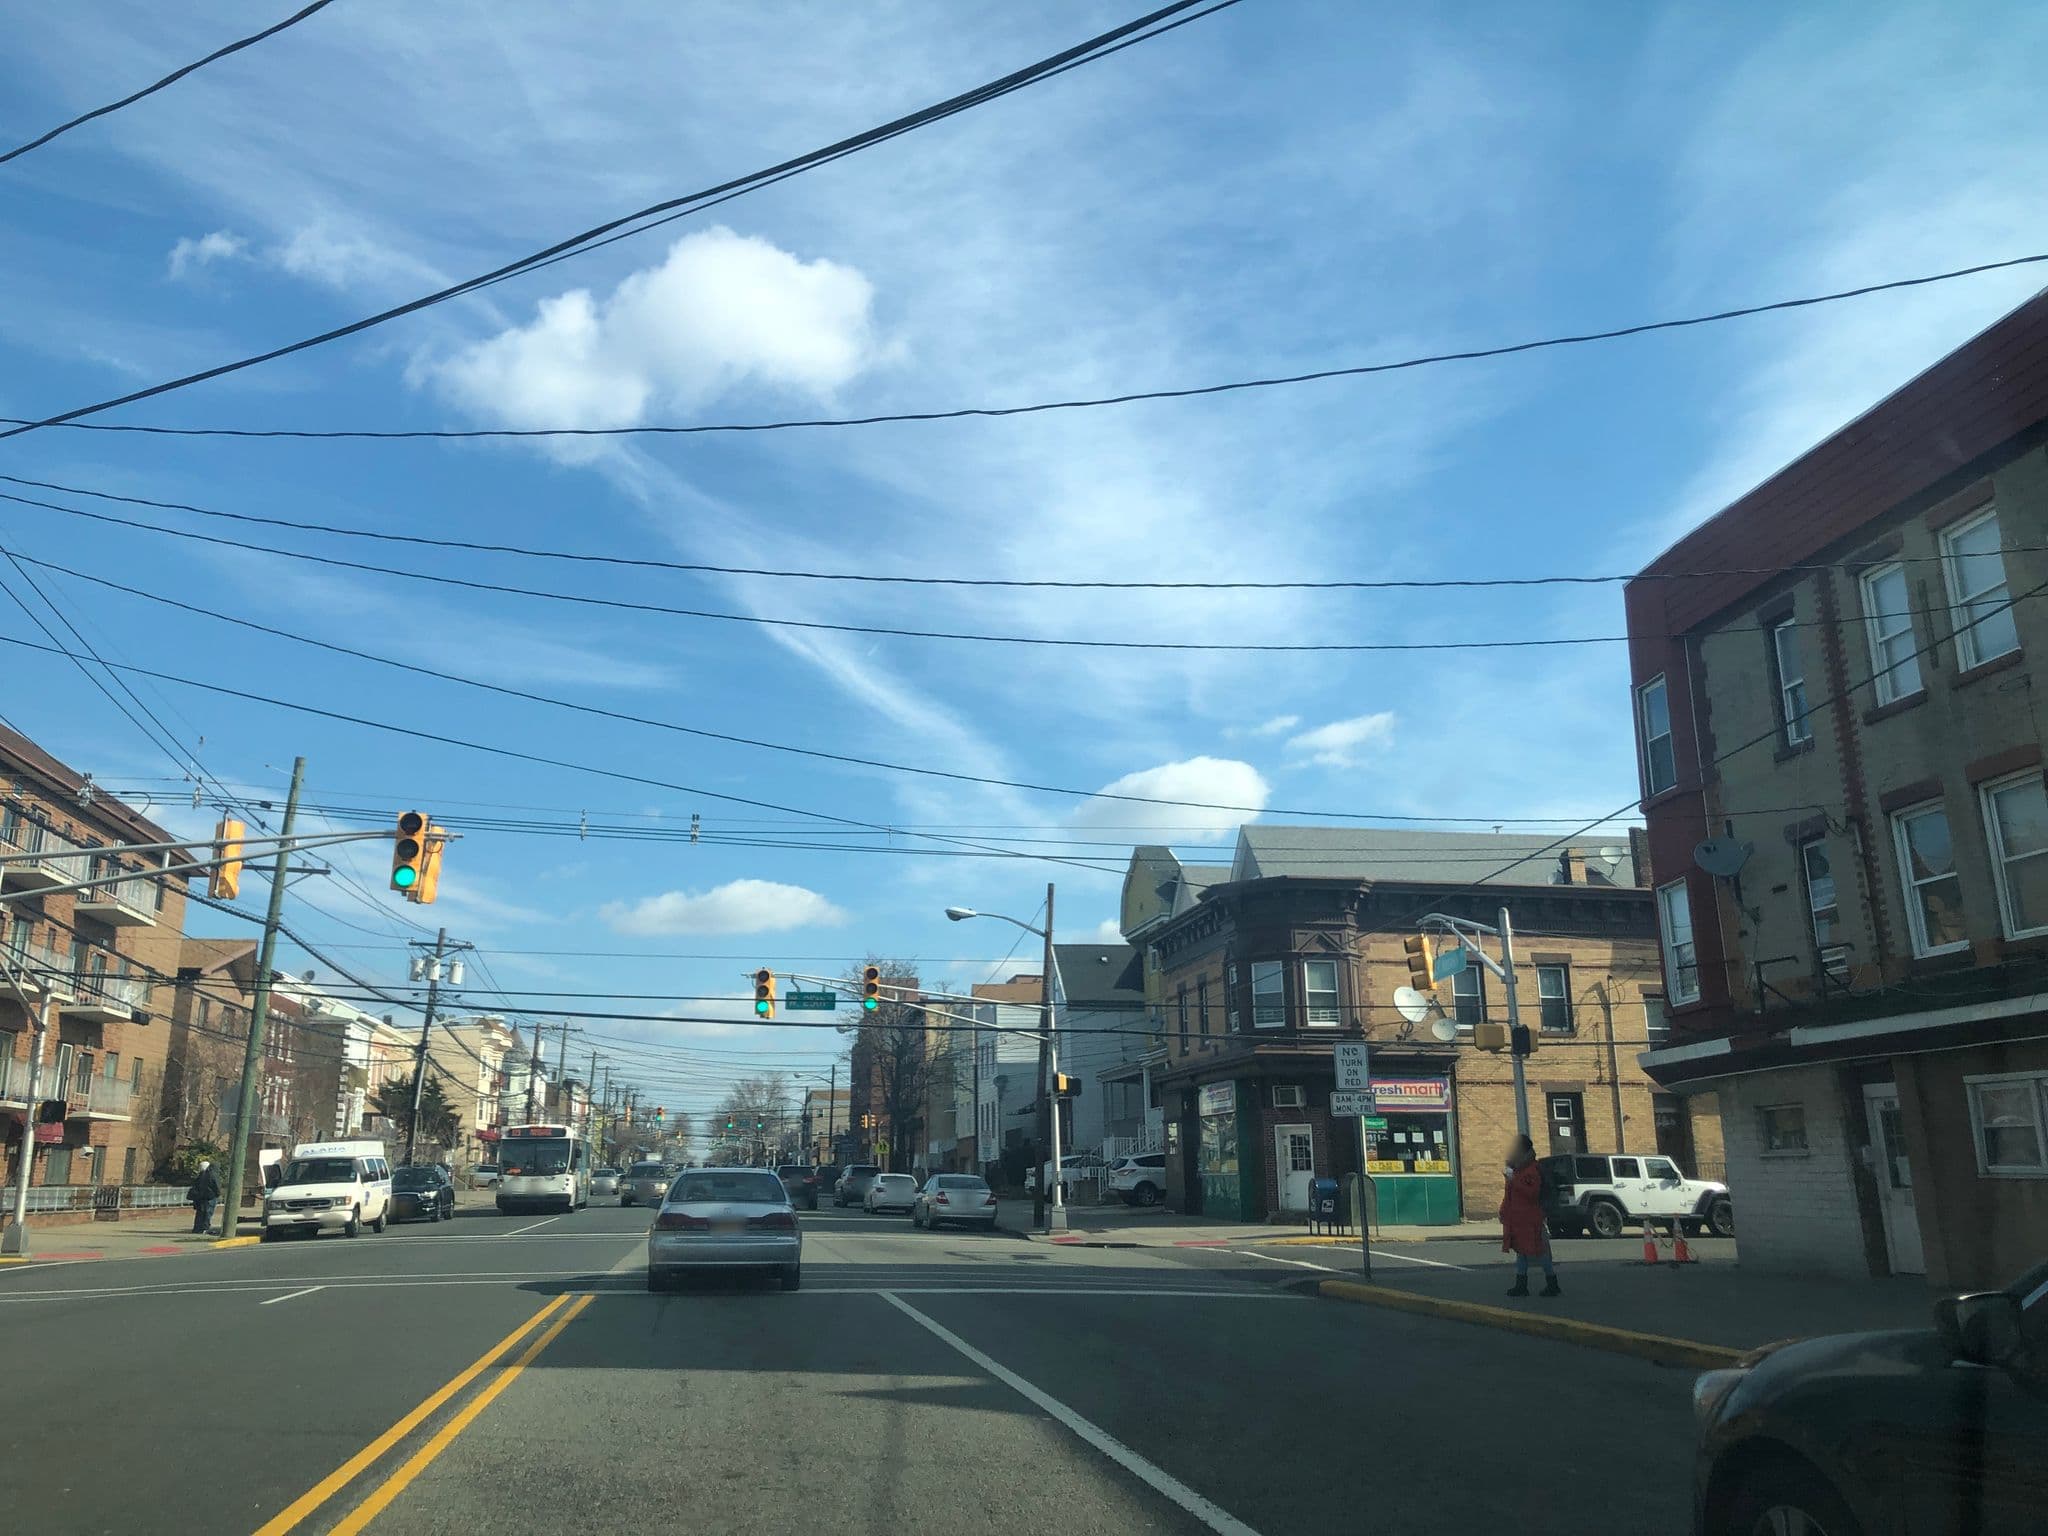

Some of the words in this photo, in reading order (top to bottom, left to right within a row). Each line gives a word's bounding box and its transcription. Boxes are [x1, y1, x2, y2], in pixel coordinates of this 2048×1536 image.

[1342, 1047, 1358, 1056] NO
[1340, 1059, 1363, 1067] TURN
[1346, 1068, 1358, 1076] ON
[1344, 1078, 1361, 1086] RED
